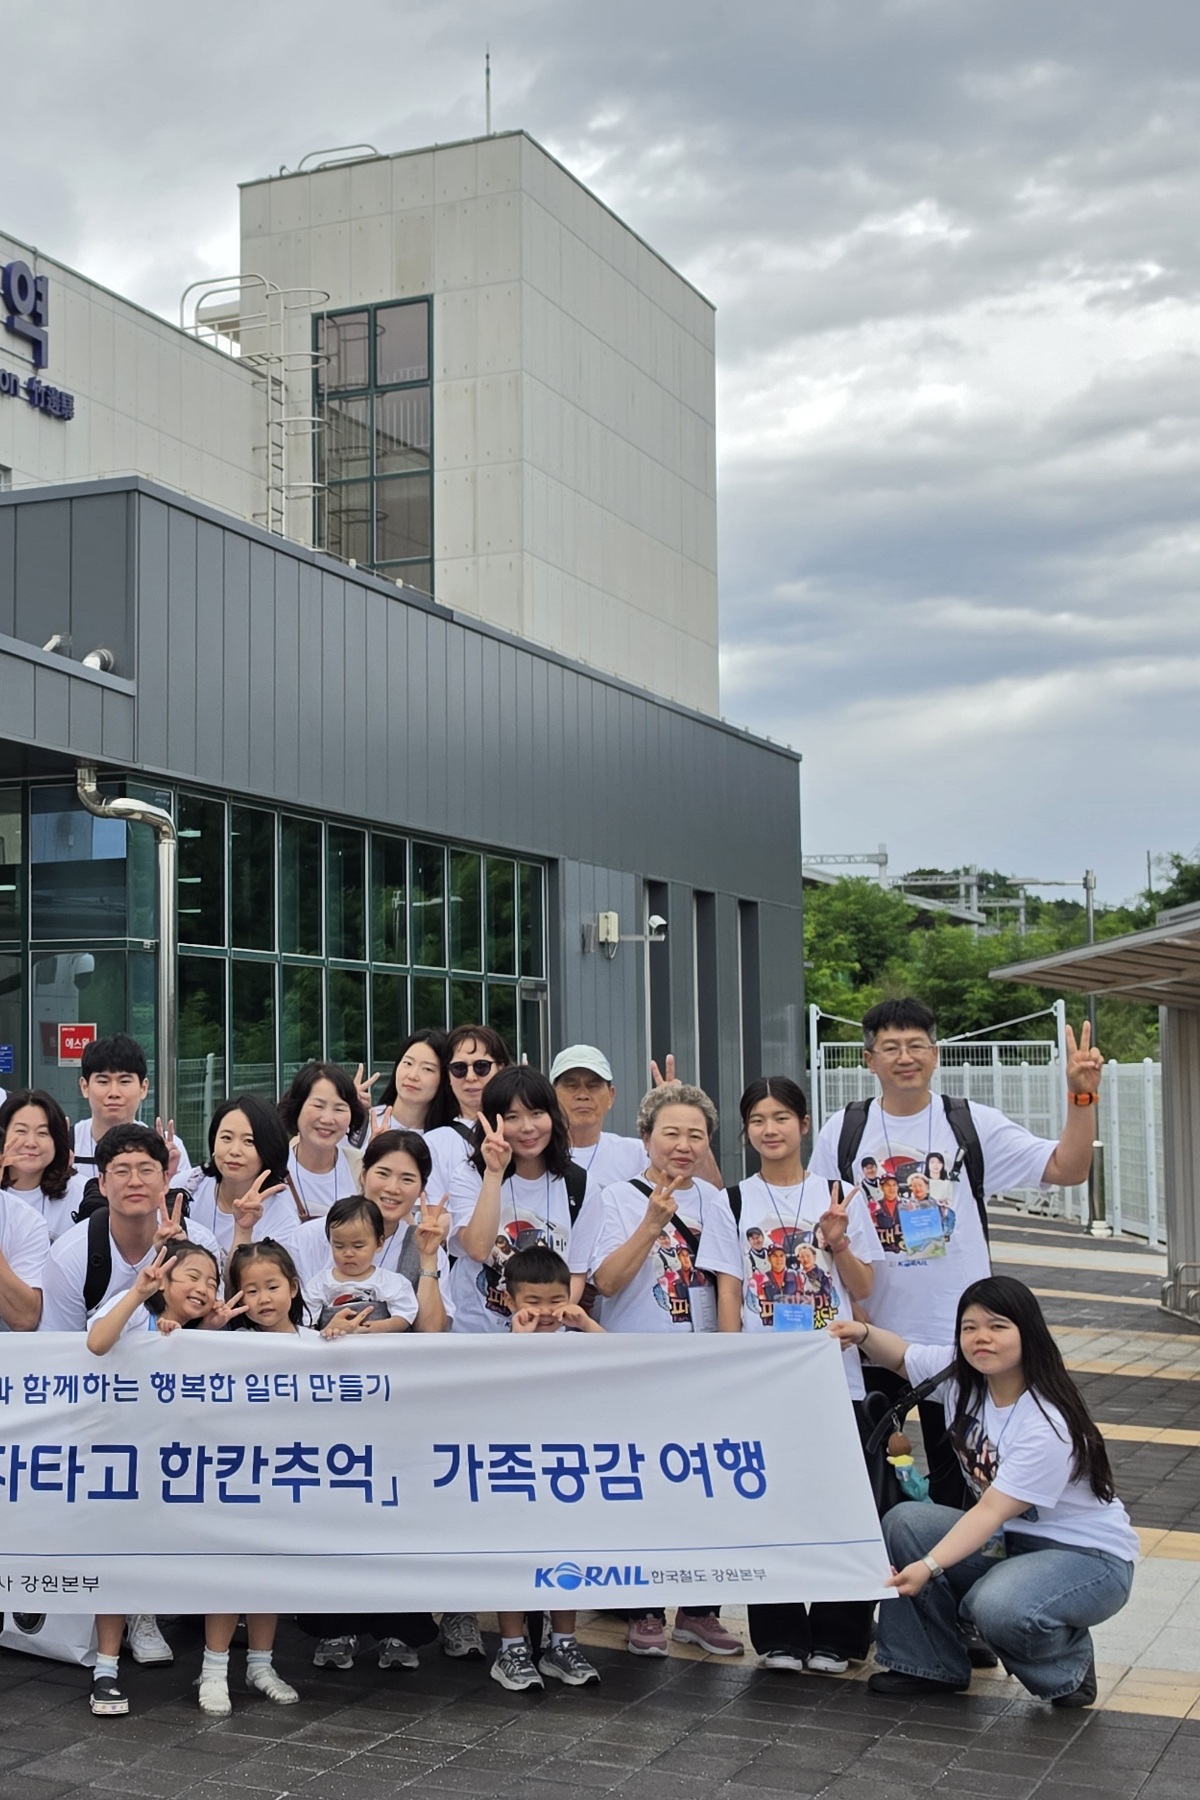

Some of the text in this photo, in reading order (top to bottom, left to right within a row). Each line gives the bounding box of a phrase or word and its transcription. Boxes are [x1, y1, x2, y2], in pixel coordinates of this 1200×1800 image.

[23, 1373, 139, 1404] 함께하는
[150, 1372, 235, 1403] 행복한
[246, 1374, 298, 1402] 일터
[310, 1375, 390, 1402] 만들기
[160, 1442, 398, 1506] 한칸추억」
[433, 1444, 645, 1503] 가족공감
[659, 1438, 767, 1500] 여행
[20, 1574, 99, 1593] 강원본부
[535, 1562, 767, 1590] KORAIL 한국철도 강원본부
